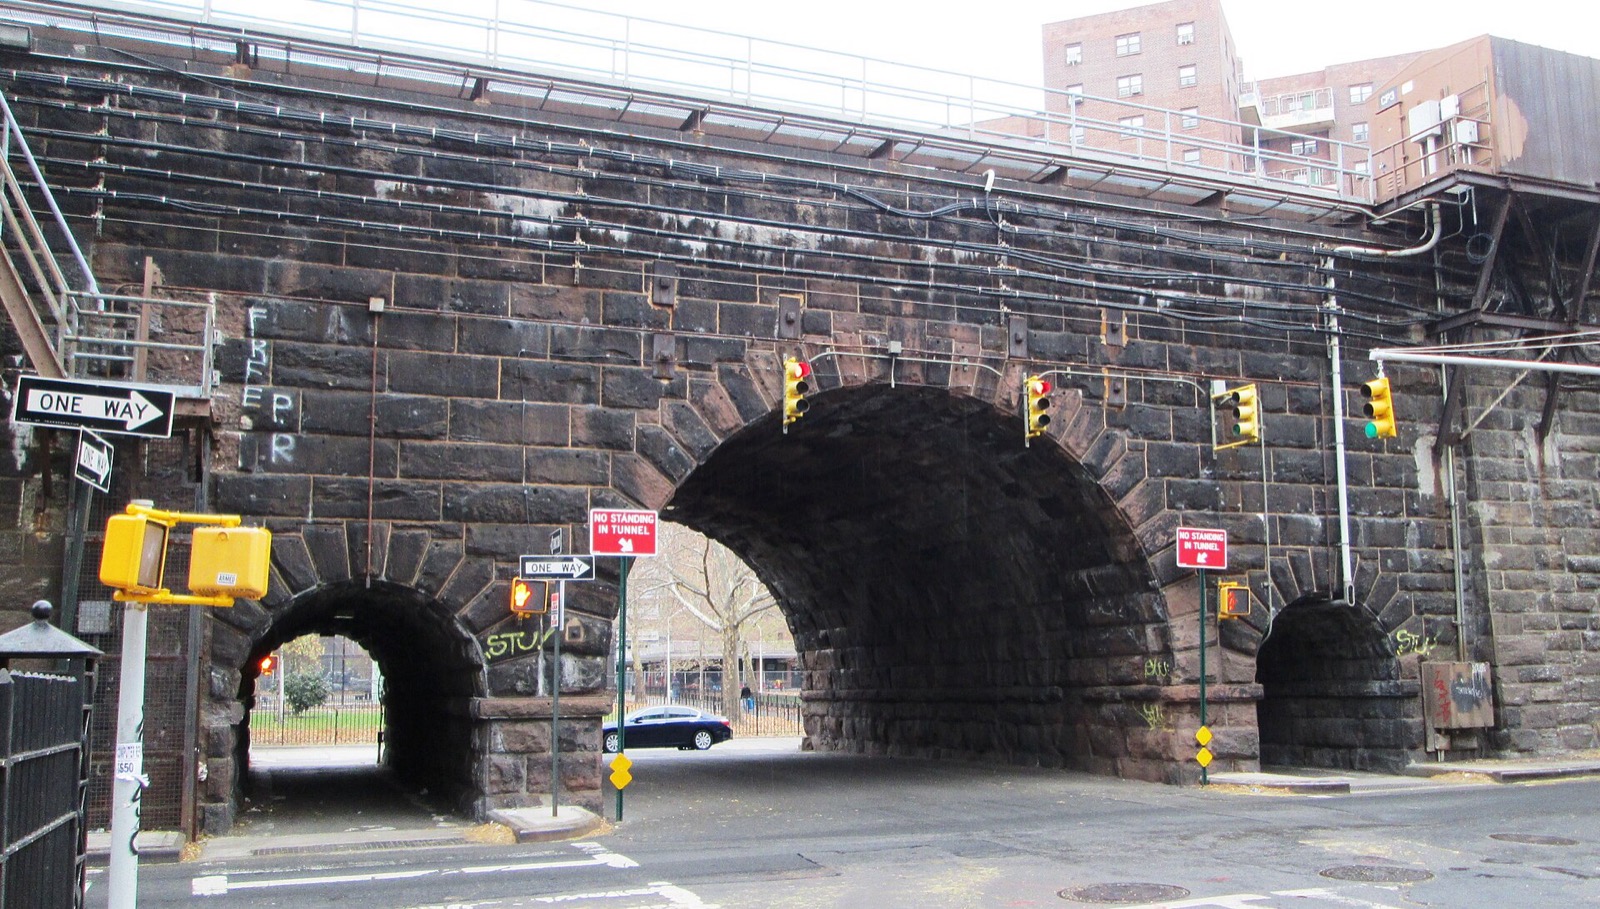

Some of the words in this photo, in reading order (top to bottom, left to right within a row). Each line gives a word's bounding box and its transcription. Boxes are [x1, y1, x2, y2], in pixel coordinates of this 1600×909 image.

[40, 393, 83, 414] ONE
[104, 399, 148, 420] WAY
[594, 513, 607, 523] NO
[610, 513, 655, 524] STANDING
[598, 525, 608, 534] IN
[612, 525, 650, 535] TUNNEL
[1179, 531, 1190, 540] NO
[1191, 532, 1224, 541] STANDING
[1194, 542, 1220, 551] TUNNEL
[531, 563, 552, 573] ONE
[561, 563, 583, 573] WAY
